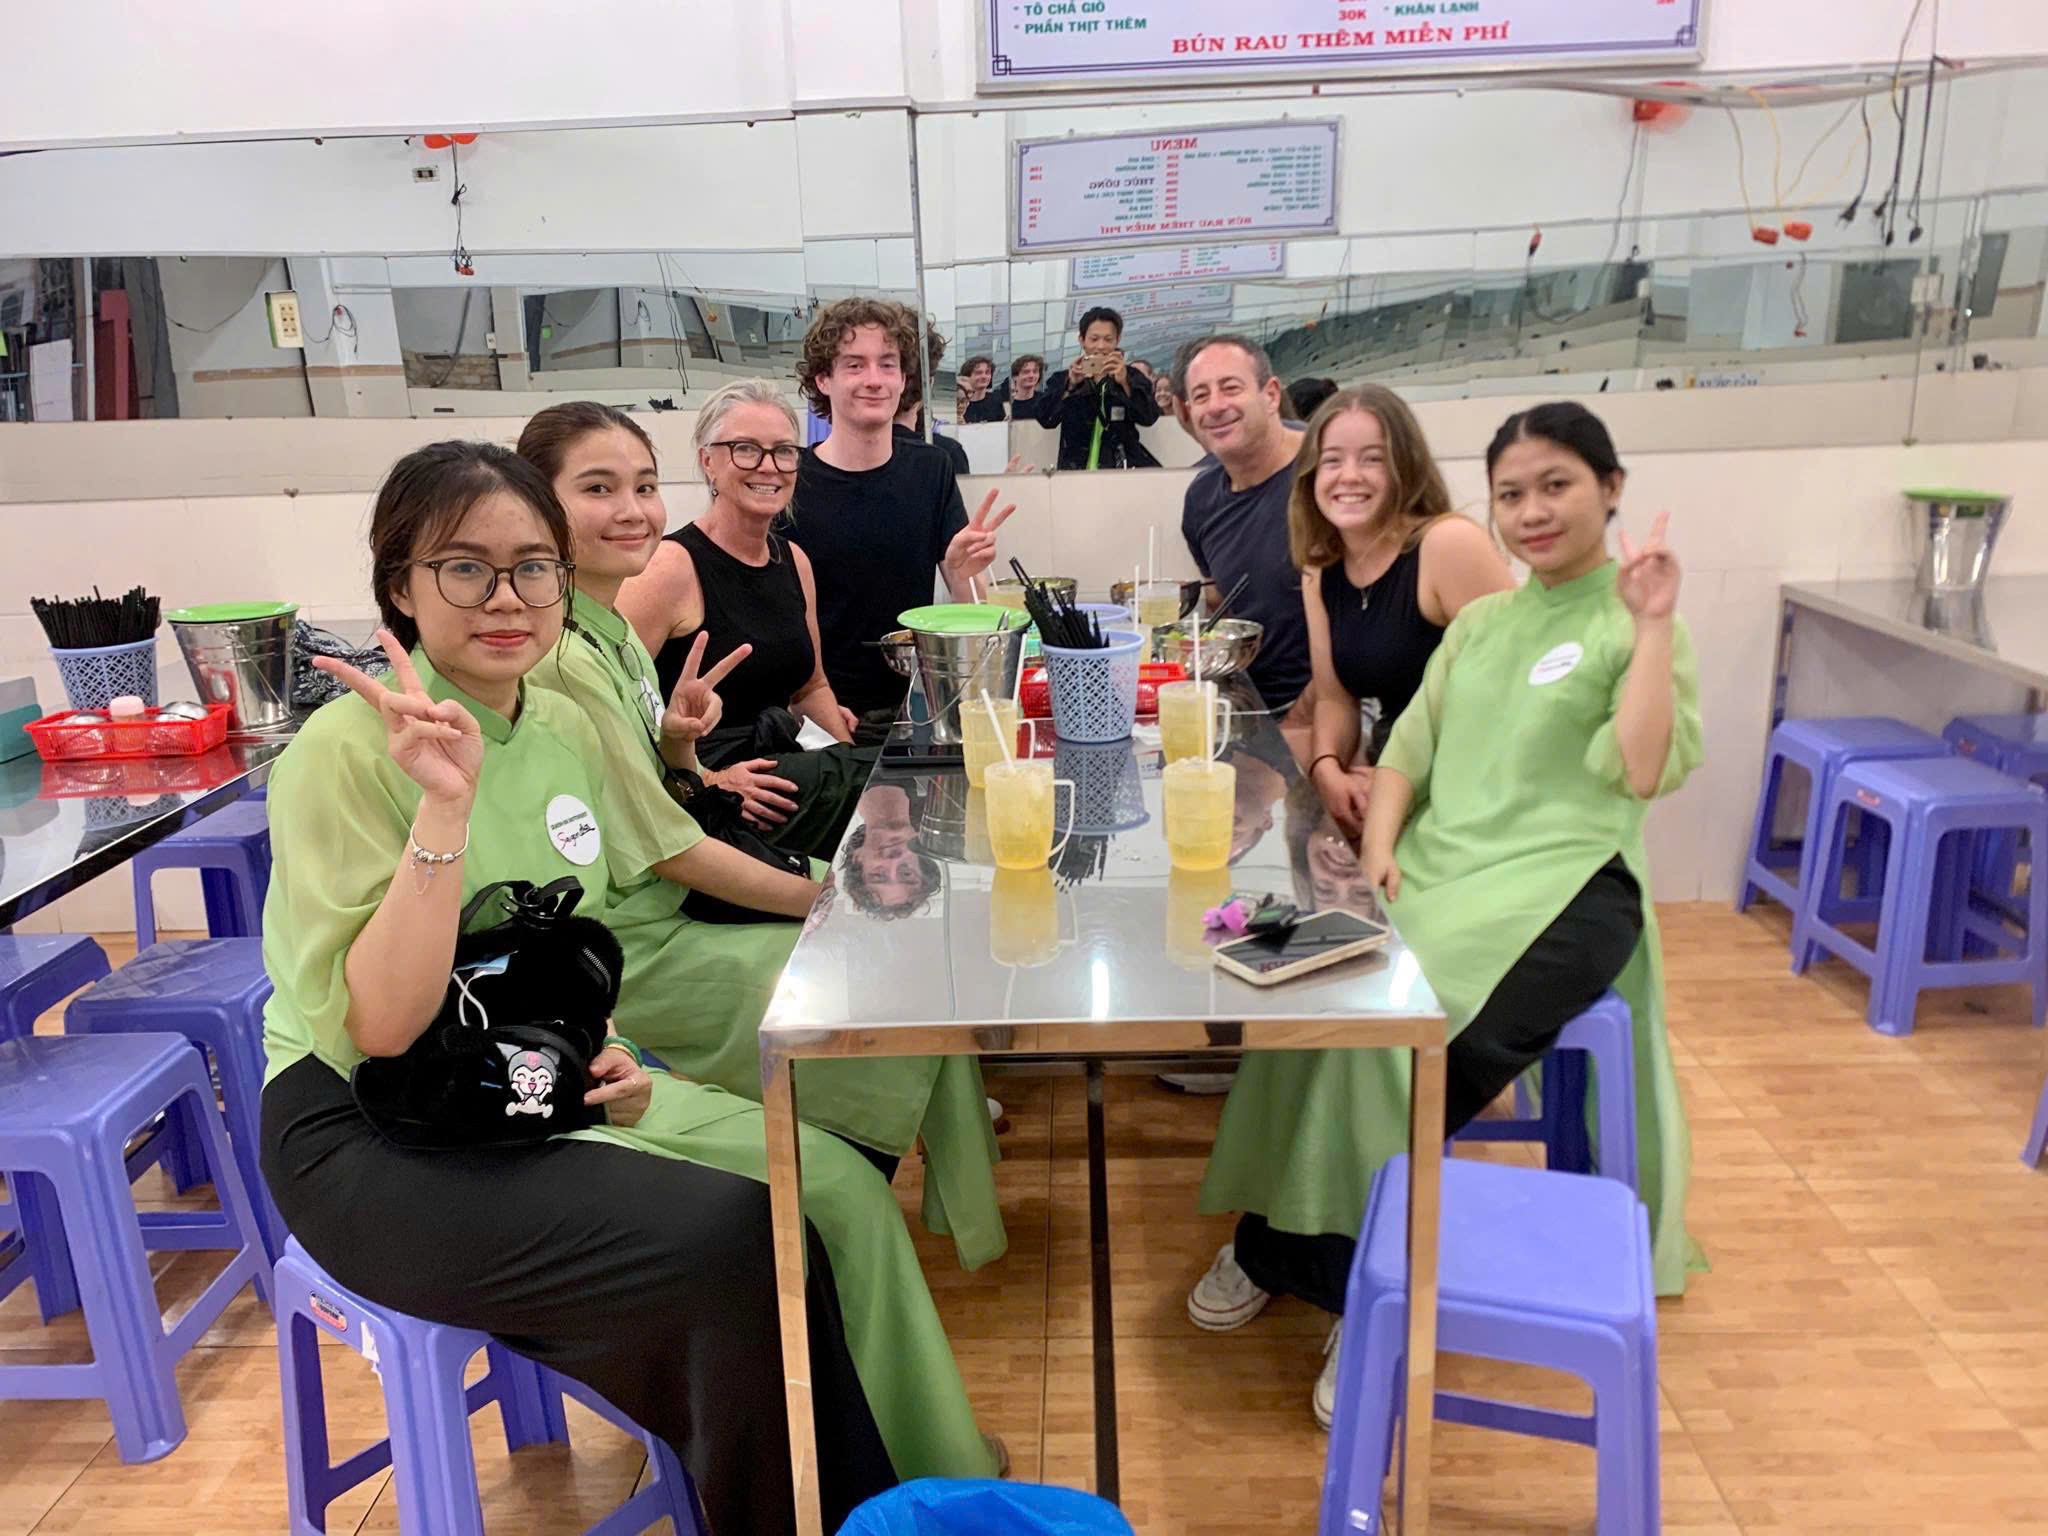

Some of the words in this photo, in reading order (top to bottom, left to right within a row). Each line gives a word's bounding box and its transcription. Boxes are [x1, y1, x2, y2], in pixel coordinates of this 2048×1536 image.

[1024, 3, 1044, 16] TÔ
[1338, 9, 1367, 21] 30K
[1068, 20, 1101, 33] THỊT
[1105, 16, 1147, 31] THÊM
[1171, 32, 1225, 54] BÚN
[1233, 35, 1288, 51] RAU
[1297, 28, 1375, 48] THÊM
[1384, 21, 1454, 45] MIỄN
[1463, 20, 1511, 41] PHÍ
